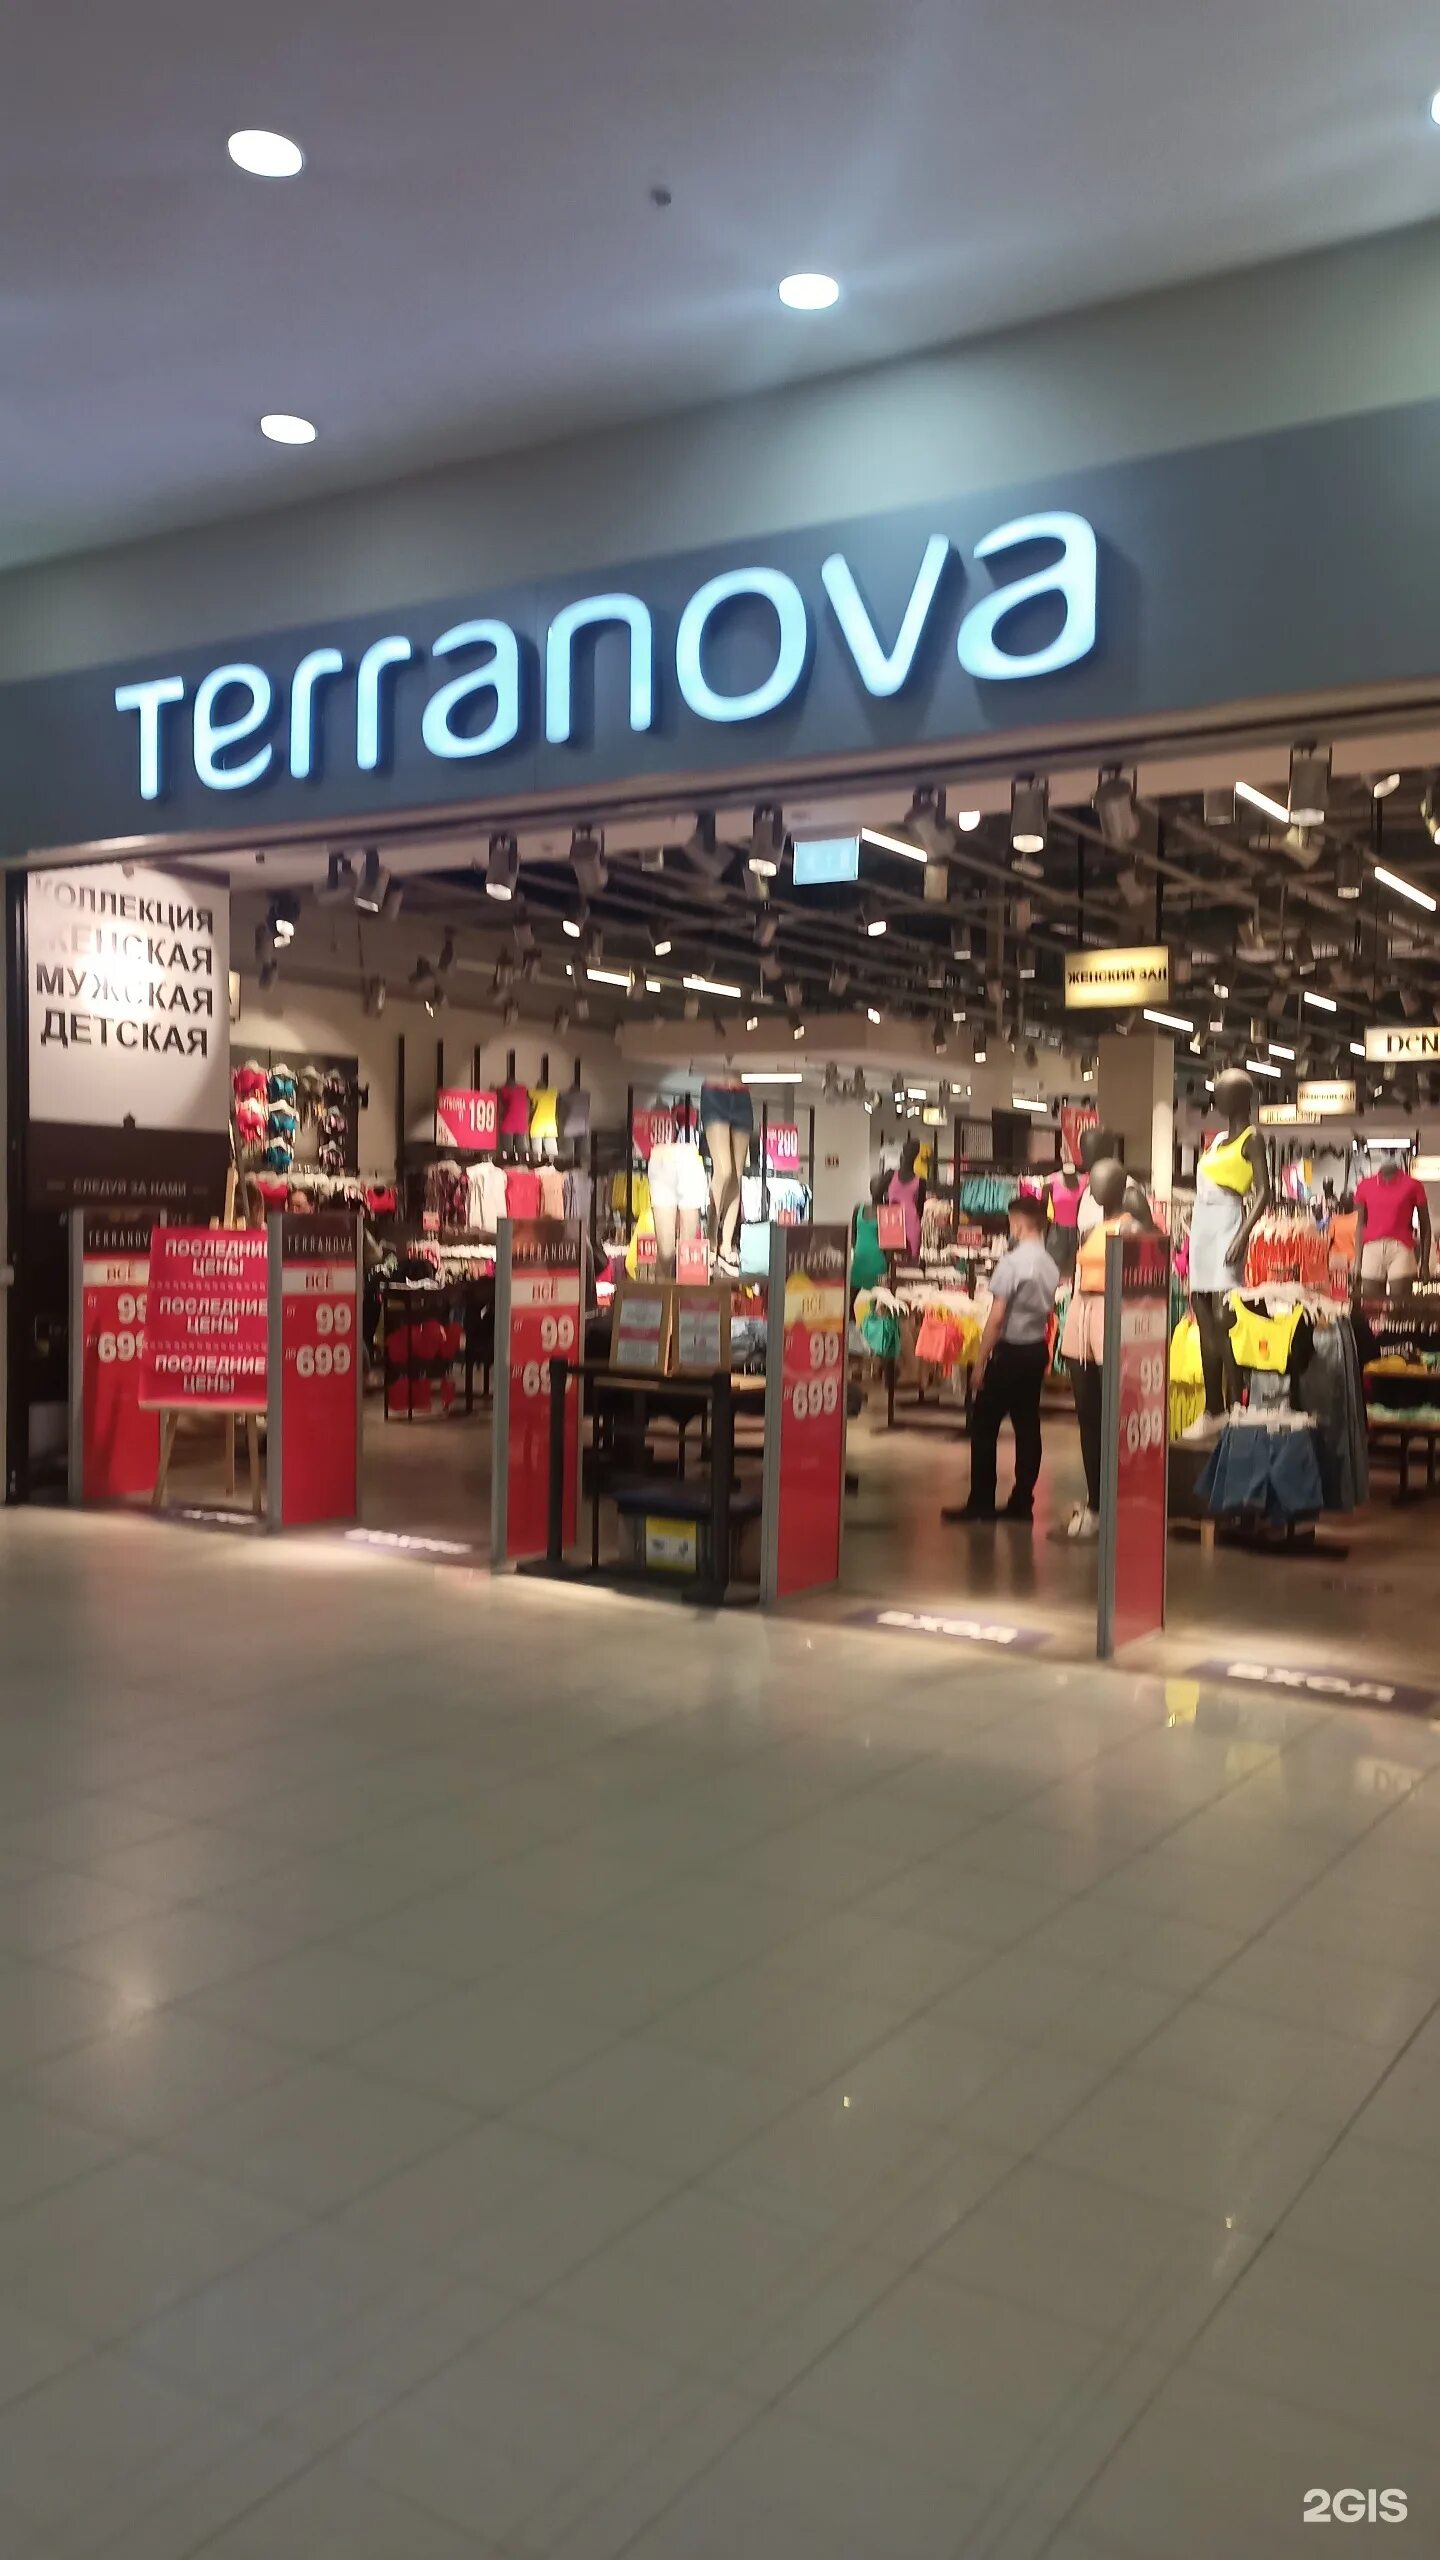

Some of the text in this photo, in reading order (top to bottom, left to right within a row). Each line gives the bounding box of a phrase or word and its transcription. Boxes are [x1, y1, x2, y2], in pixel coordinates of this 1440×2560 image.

[36, 962, 213, 1017] МУЖСКАЯ
[40, 1007, 208, 1059] ДЕТСКАЯ
[89, 1230, 150, 1248] TERRANOV
[287, 1235, 353, 1253] TERRANOVA
[515, 1241, 577, 1261] TERRANOVA
[193, 1257, 244, 1278] ЦЕНЫ
[160, 1296, 267, 1317] ПОСЛЕДНИЕ
[316, 1302, 351, 1335] 99
[187, 1315, 239, 1336] ЦЕНЫ
[541, 1315, 574, 1351] 99
[155, 1354, 266, 1376] ПОСЛЕДНИЕ
[296, 1343, 350, 1378] 699
[810, 1331, 839, 1370] 99
[183, 1374, 235, 1395] ЦЕНЫ
[523, 1359, 572, 1397] 69
[1140, 1357, 1163, 1396] 99
[792, 1375, 838, 1420] 699
[1127, 1408, 1163, 1449] 699
